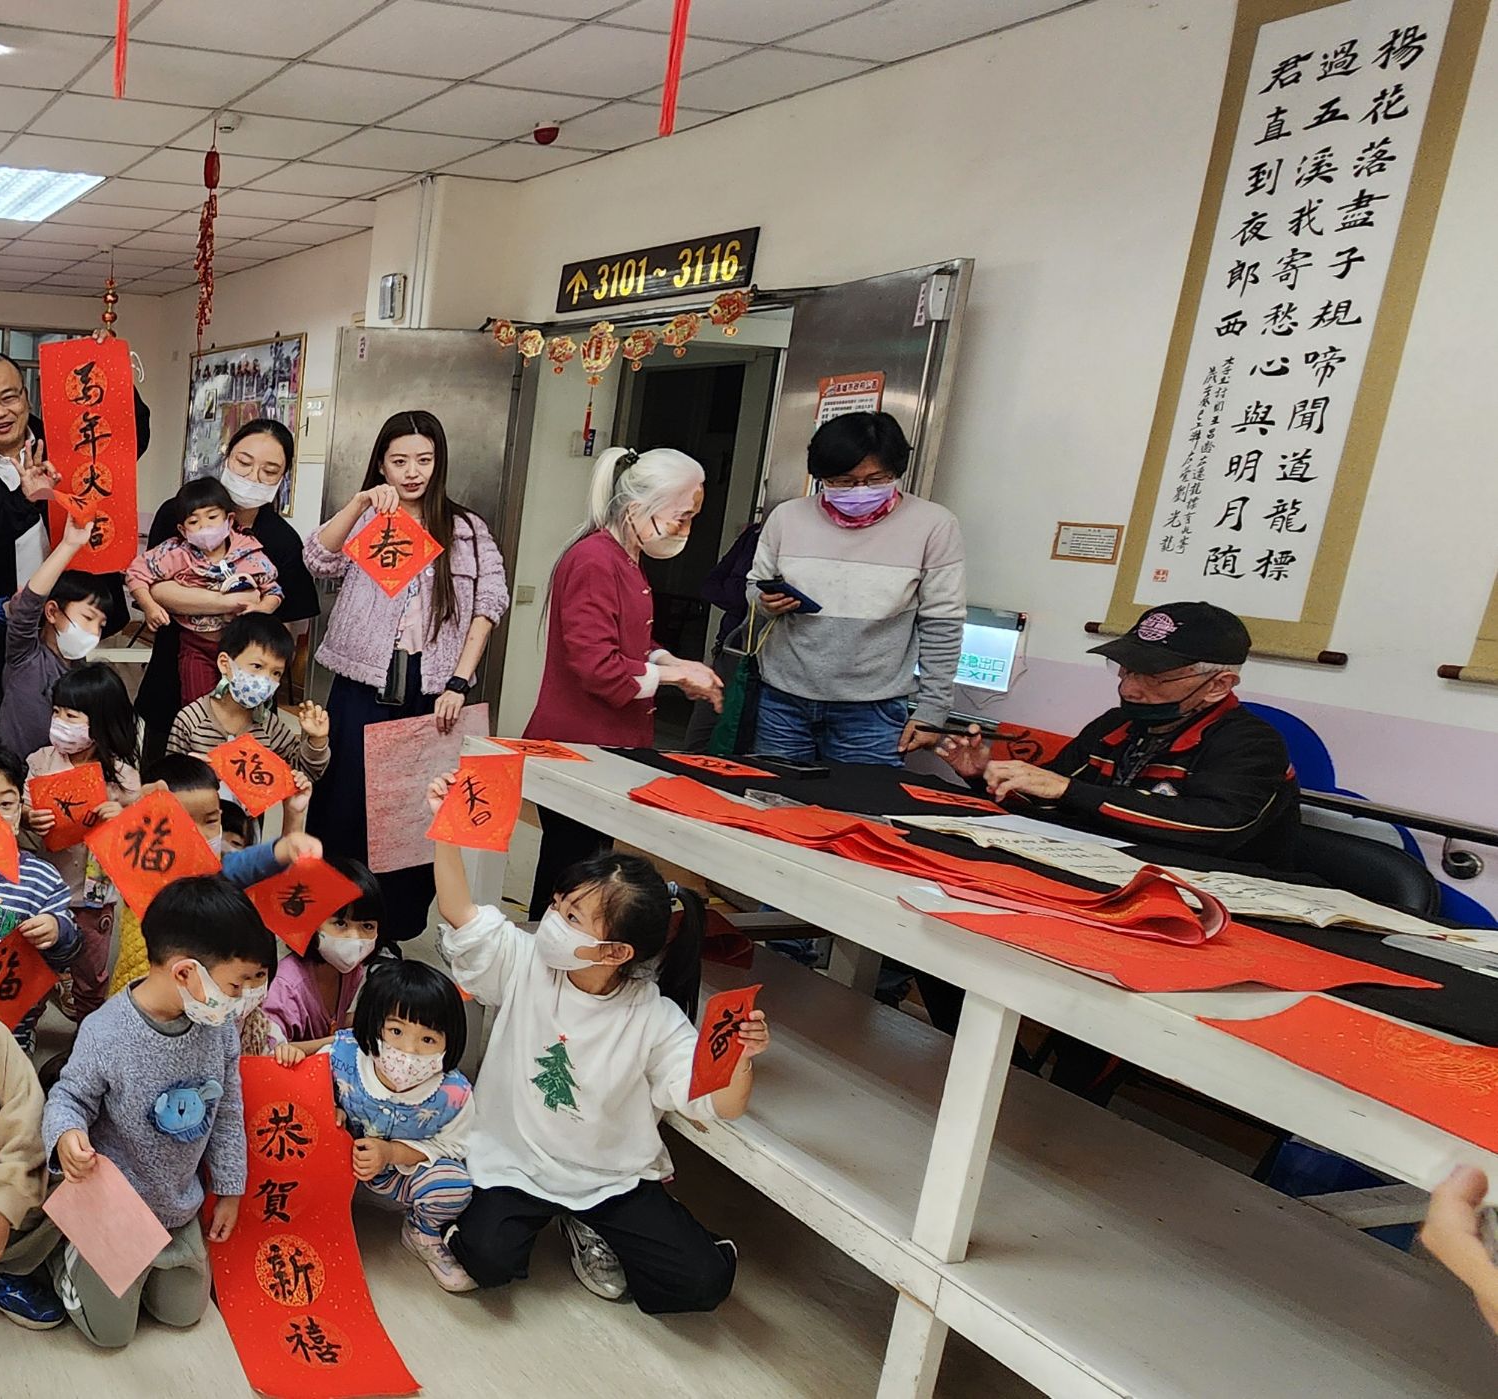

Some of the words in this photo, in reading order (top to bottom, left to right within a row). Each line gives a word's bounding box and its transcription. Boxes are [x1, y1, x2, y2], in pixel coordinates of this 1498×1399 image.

[1215, 50, 1315, 337] 君直到夜郎西
[366, 516, 414, 569] 春
[956, 669, 1001, 682] EXIT
[230, 750, 274, 786] 福
[122, 815, 176, 872] 福
[708, 1002, 746, 1061] 福
[254, 1103, 342, 1364] 恭賀新禧
